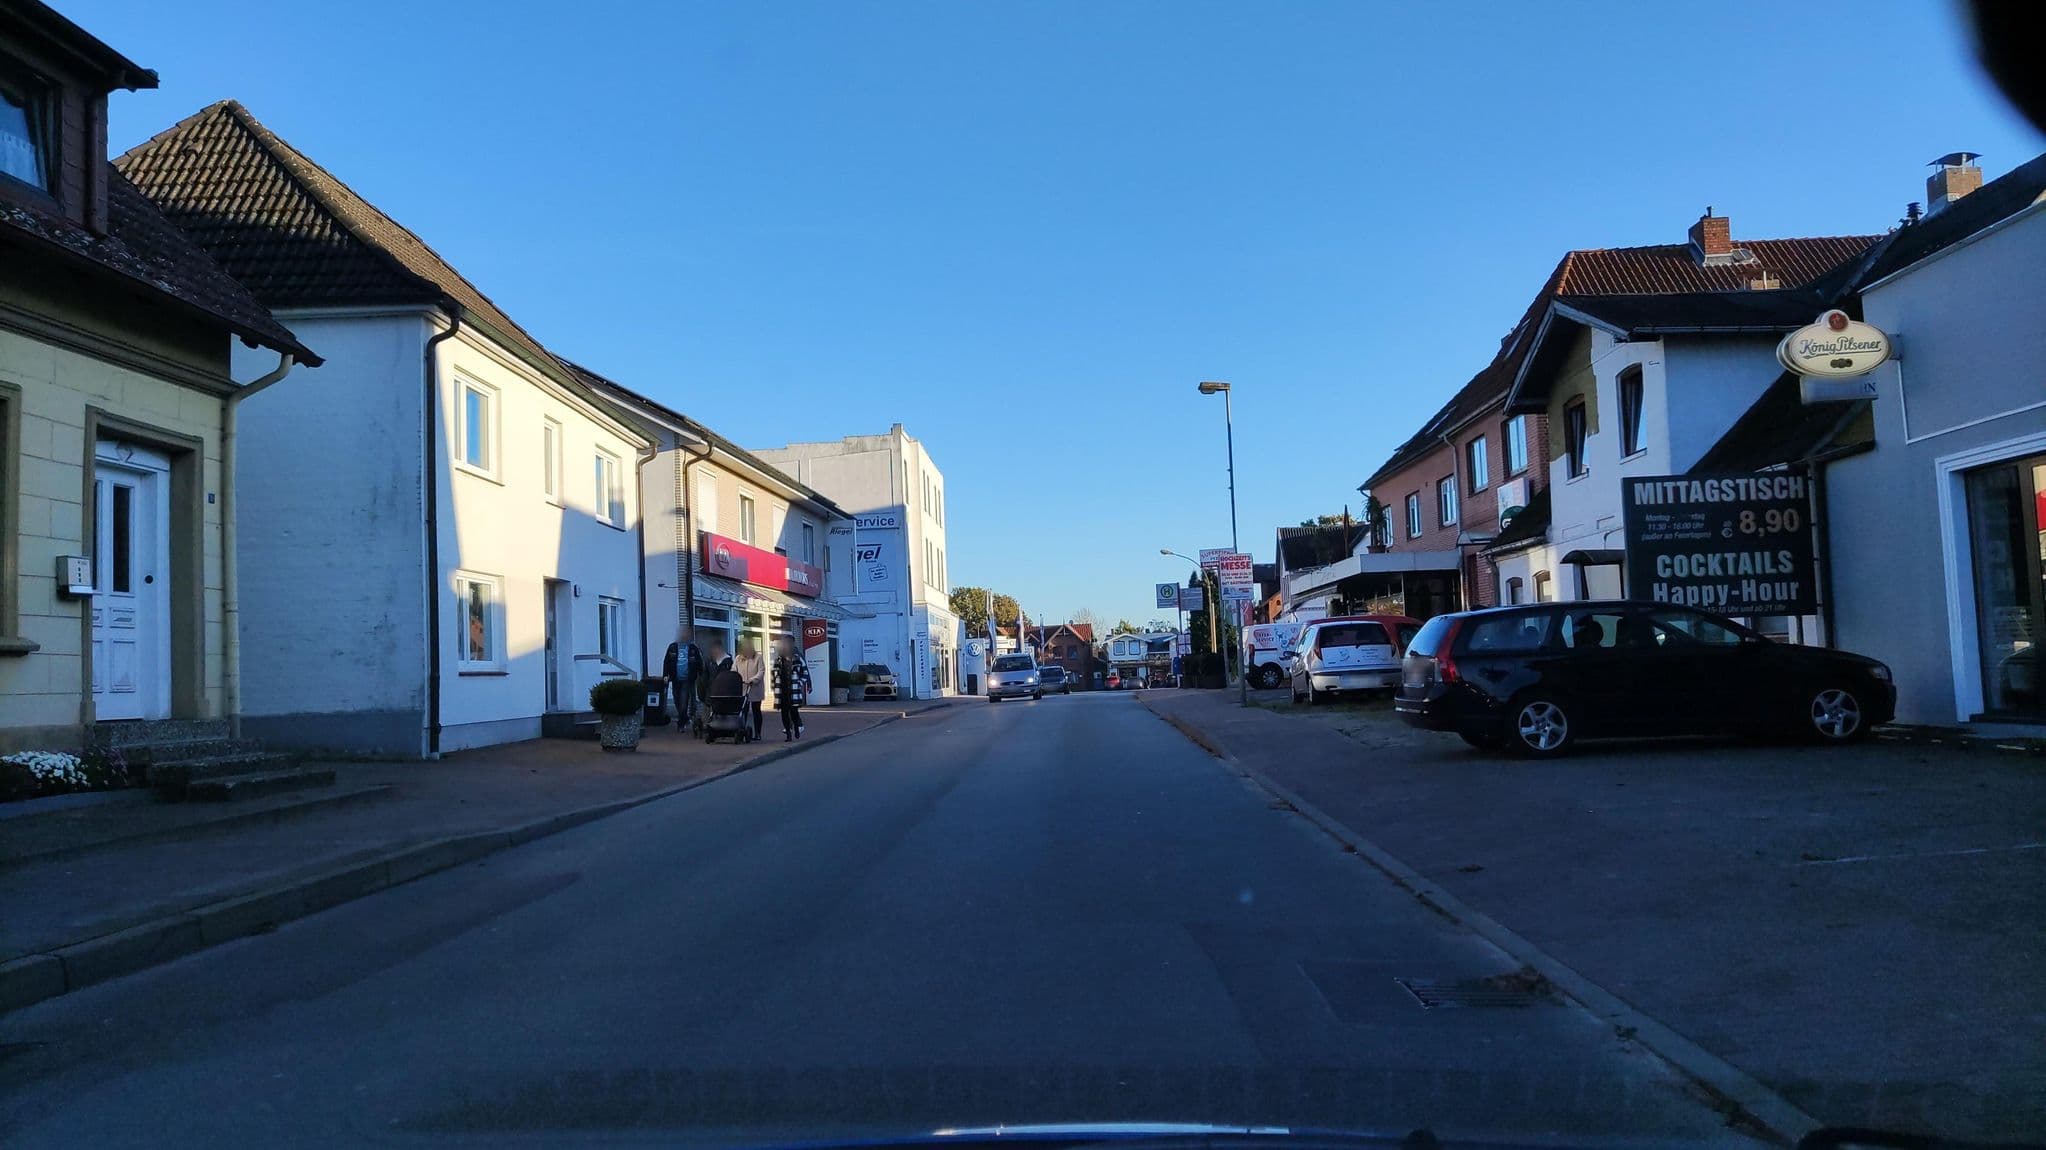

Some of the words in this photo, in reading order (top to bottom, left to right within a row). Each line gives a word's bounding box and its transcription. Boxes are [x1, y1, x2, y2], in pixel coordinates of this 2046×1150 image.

[1800, 339, 1837, 355] König
[1837, 336, 1881, 352] Pilsener
[1634, 476, 1804, 505] MITTAGSTISCH
[1739, 508, 1800, 537] 8,90
[1221, 561, 1251, 570] MESSE
[1656, 550, 1794, 579] COCKTAILS
[1653, 579, 1800, 607] Happy-Hour
